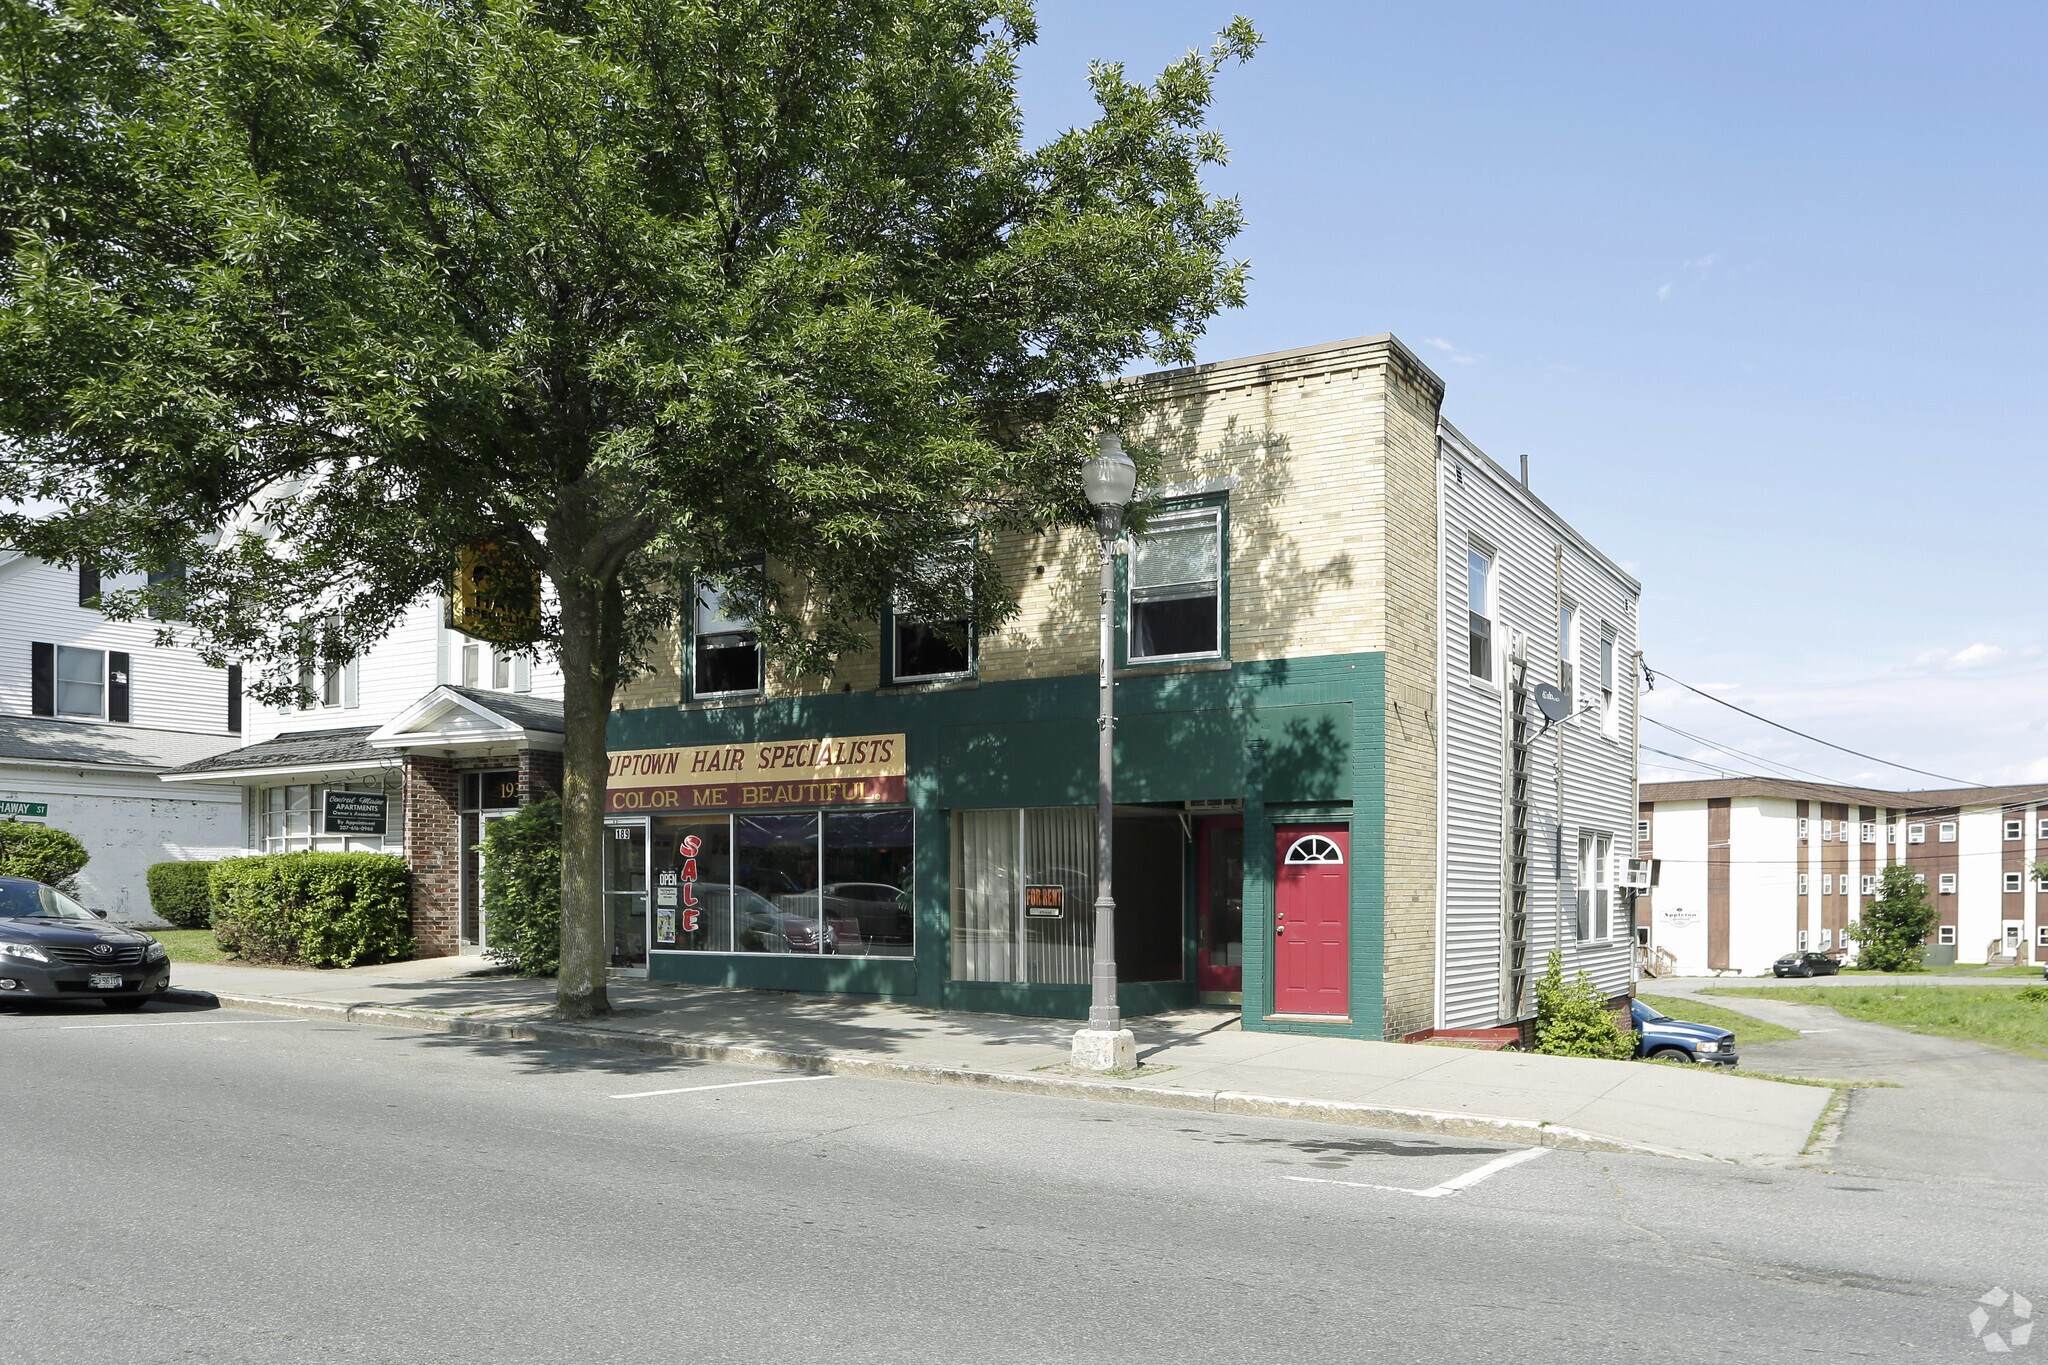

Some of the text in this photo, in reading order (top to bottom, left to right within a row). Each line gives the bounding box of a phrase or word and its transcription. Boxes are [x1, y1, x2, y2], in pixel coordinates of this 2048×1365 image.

[608, 739, 894, 777] UPTOWN HAIR SPECIALISTS
[359, 796, 384, 805] Maine
[612, 790, 680, 810] COLOR
[692, 788, 728, 806] ME
[36, 806, 45, 814] ST
[336, 804, 378, 812] APARTMENTS
[616, 829, 630, 839] 189
[660, 874, 677, 886] OPEN
[680, 835, 702, 932] SALE
[1026, 888, 1062, 906] FOR RENT
